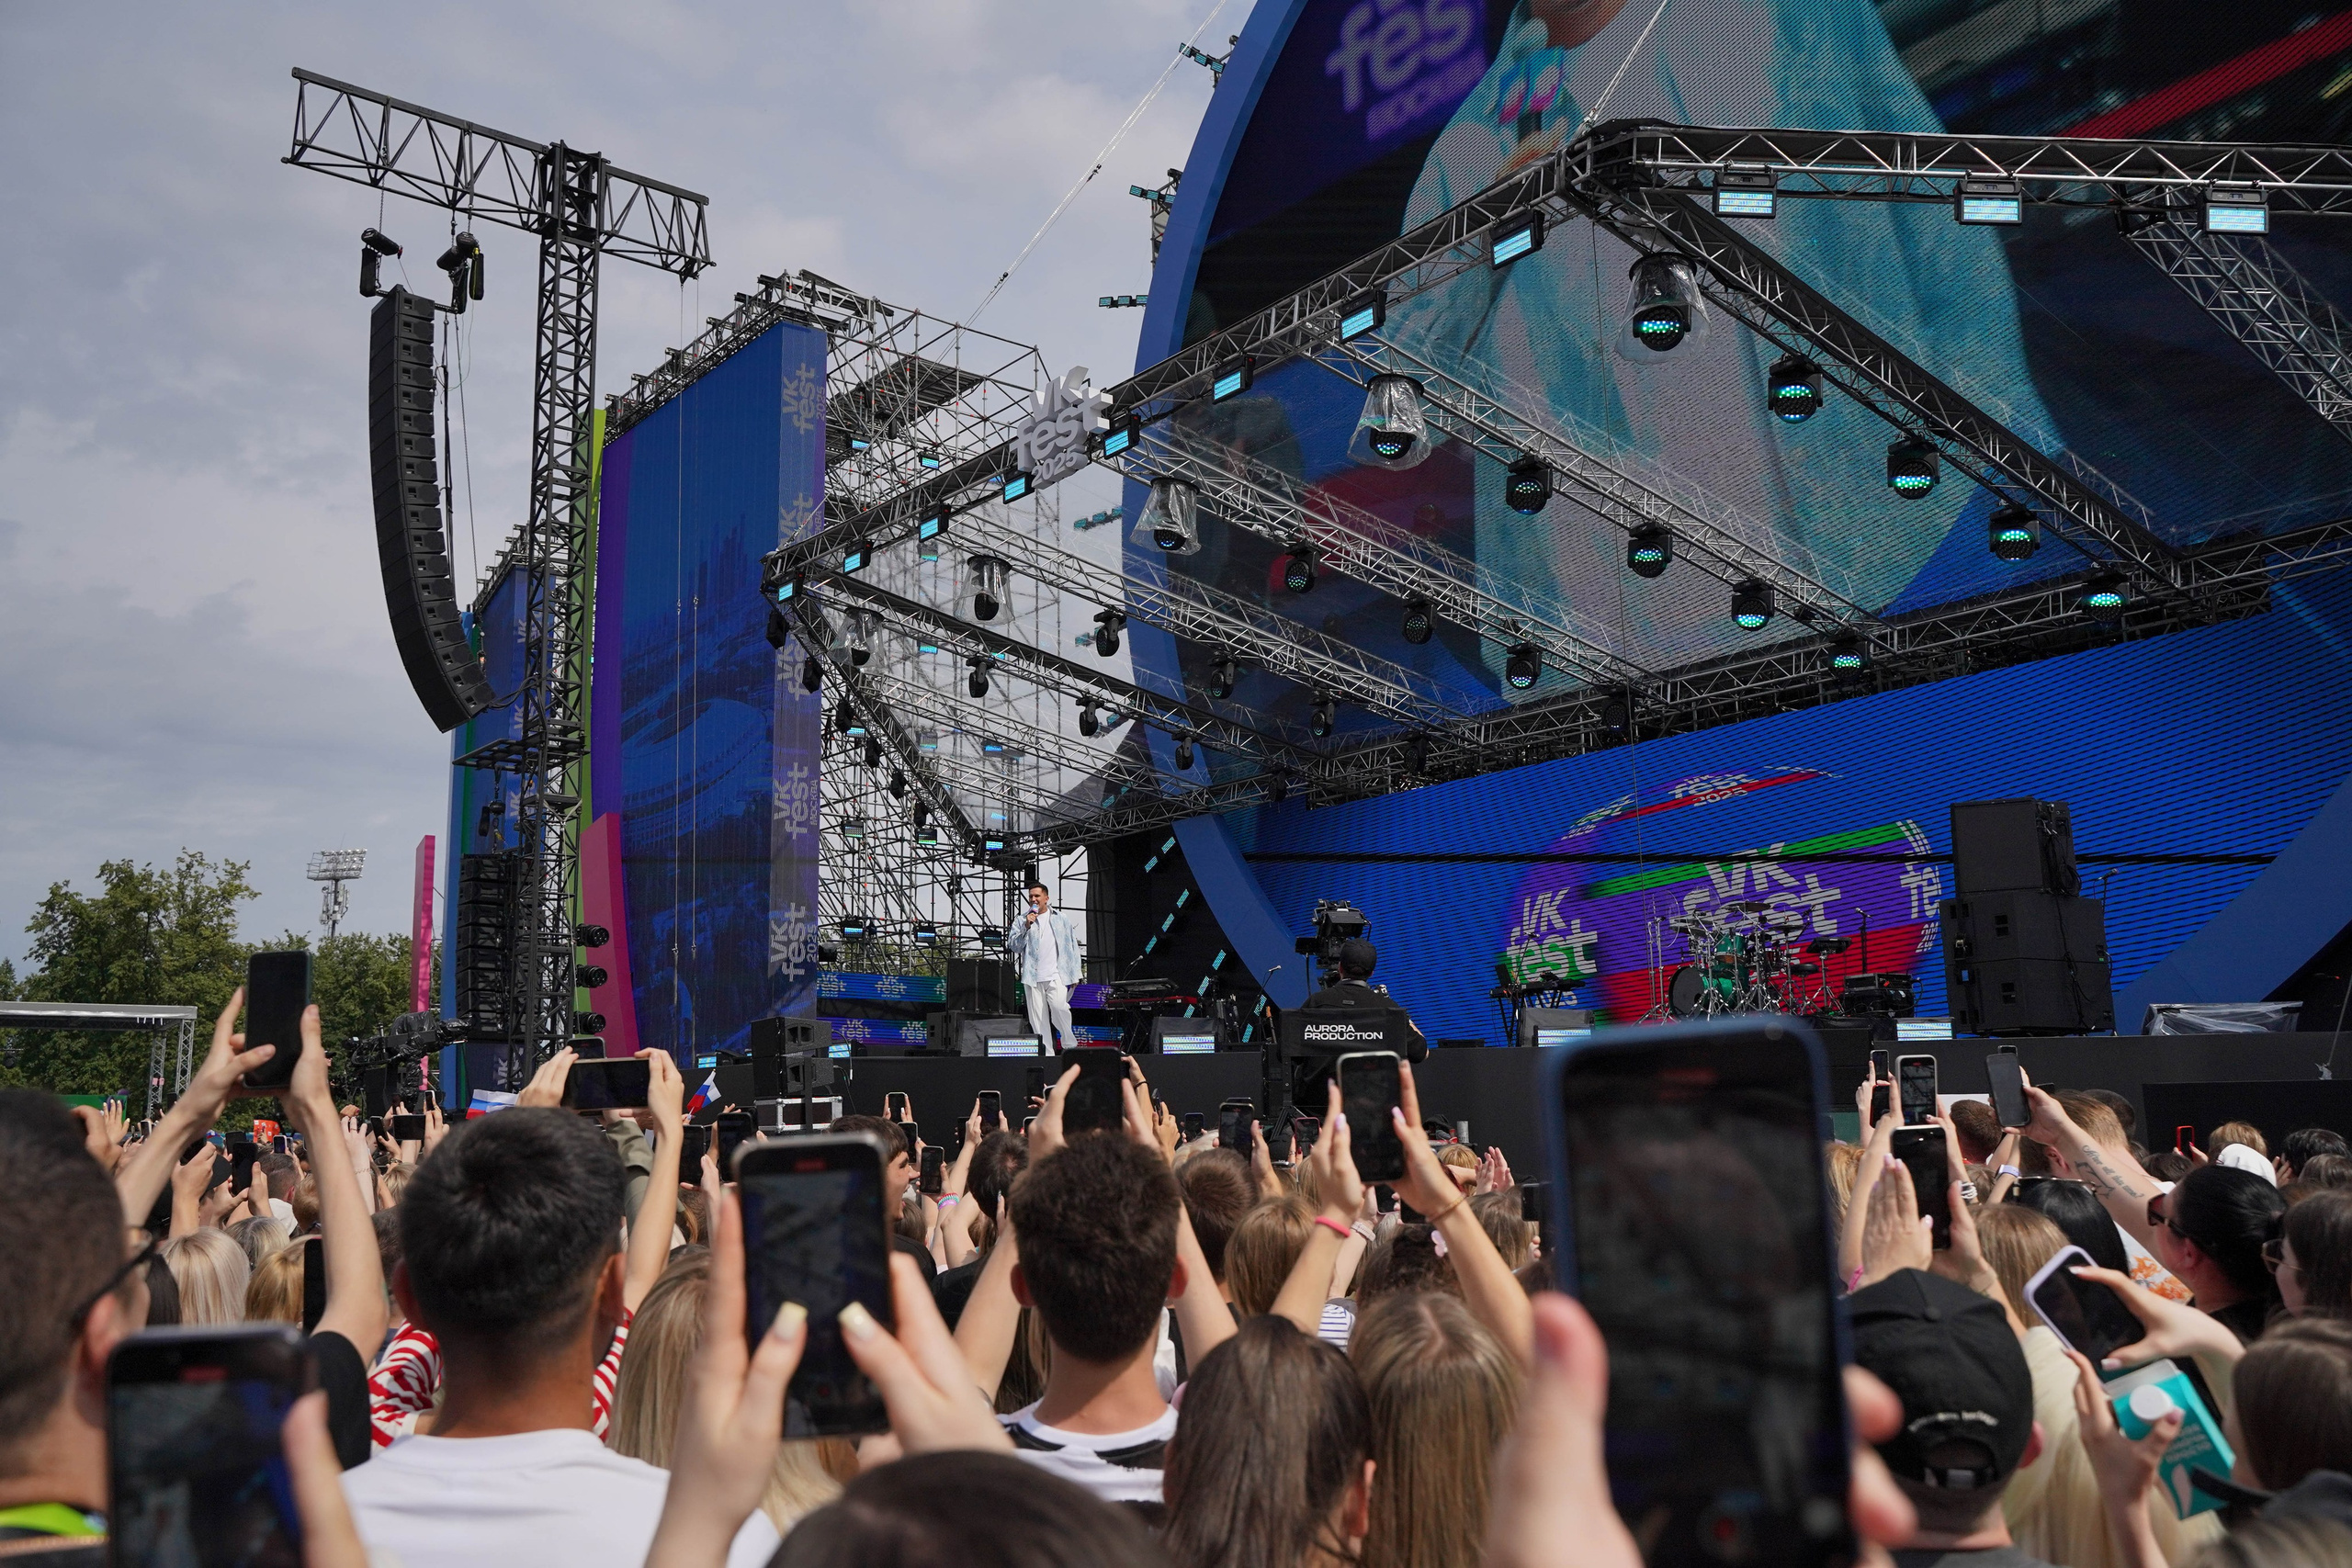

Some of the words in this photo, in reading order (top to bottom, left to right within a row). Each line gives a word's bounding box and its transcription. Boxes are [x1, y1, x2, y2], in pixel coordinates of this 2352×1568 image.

[782, 376, 798, 414] VK
[792, 363, 816, 435] fest
[1029, 366, 1089, 423] VK
[1010, 387, 1113, 472] fest
[1031, 444, 1089, 490] 2025
[776, 643, 794, 681] VK
[774, 778, 791, 820] VK
[785, 761, 808, 840] fest
[1692, 787, 1748, 807] 2025
[1704, 842, 1800, 898] VK
[1522, 887, 1571, 937] VK
[770, 920, 788, 963] VK
[781, 902, 807, 982] fest
[806, 924, 818, 963] 2025
[1507, 919, 1598, 984] fest
[875, 980, 908, 994] fest
[840, 1024, 872, 1038] fest
[846, 1020, 865, 1028] VK
[907, 1021, 923, 1030] VK
[1304, 1032, 1383, 1040] PRODUCTION
[1305, 1024, 1355, 1032] AURORA
[497, 1058, 508, 1085] VK
